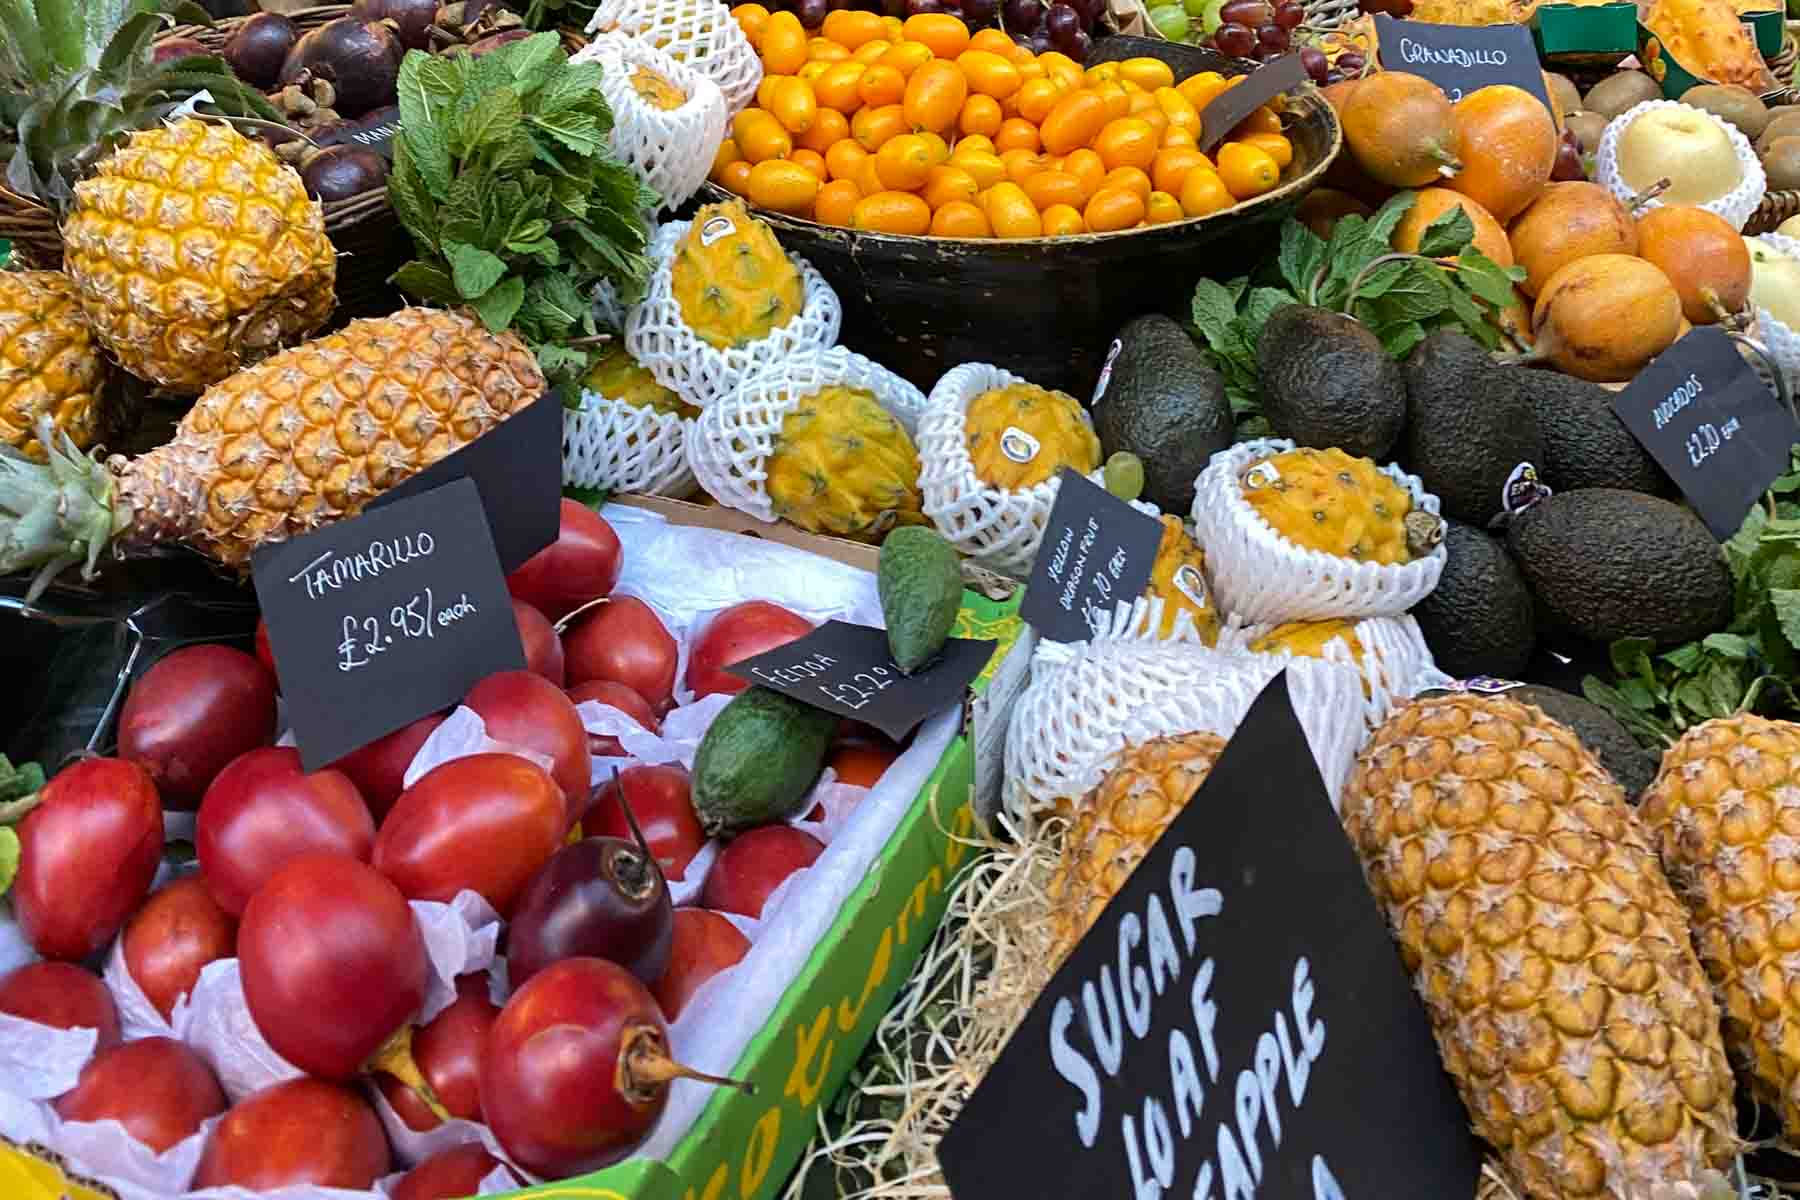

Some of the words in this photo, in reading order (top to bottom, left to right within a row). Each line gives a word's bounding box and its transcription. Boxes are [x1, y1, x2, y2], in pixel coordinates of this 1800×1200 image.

[1400, 38, 1507, 68] GRANADILLO
[288, 532, 436, 600] TAMARILLO
[1047, 527, 1074, 584] YELLOW
[751, 652, 839, 688] FEIJOA
[1050, 846, 1225, 1149] SUGAR
[1122, 956, 1220, 1200] LOAF
